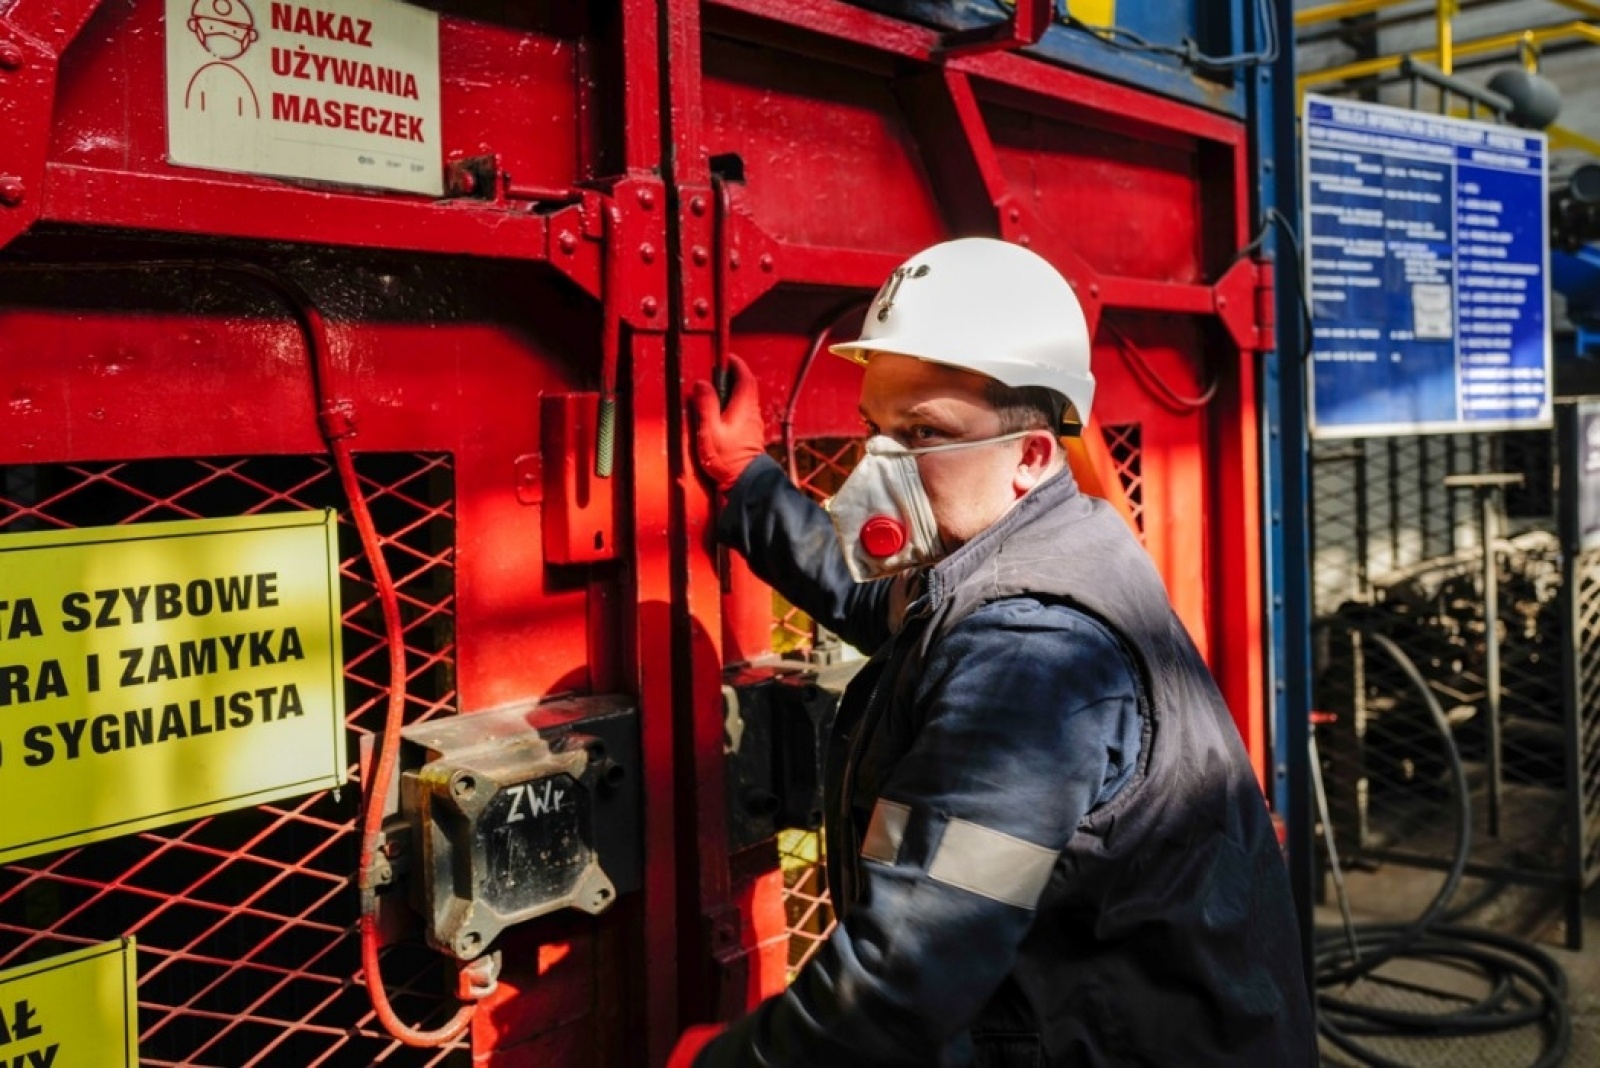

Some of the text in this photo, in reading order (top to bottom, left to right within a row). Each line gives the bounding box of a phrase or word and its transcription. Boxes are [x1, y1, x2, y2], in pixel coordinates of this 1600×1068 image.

[270, 2, 373, 47] NAKAZ
[271, 44, 419, 100] UŻYWANIA
[272, 92, 425, 143] MASECZEK
[61, 571, 279, 632] SZYBOWE
[0, 627, 305, 706] RA I ZAMYKA
[23, 683, 304, 767] SYGNALISTA
